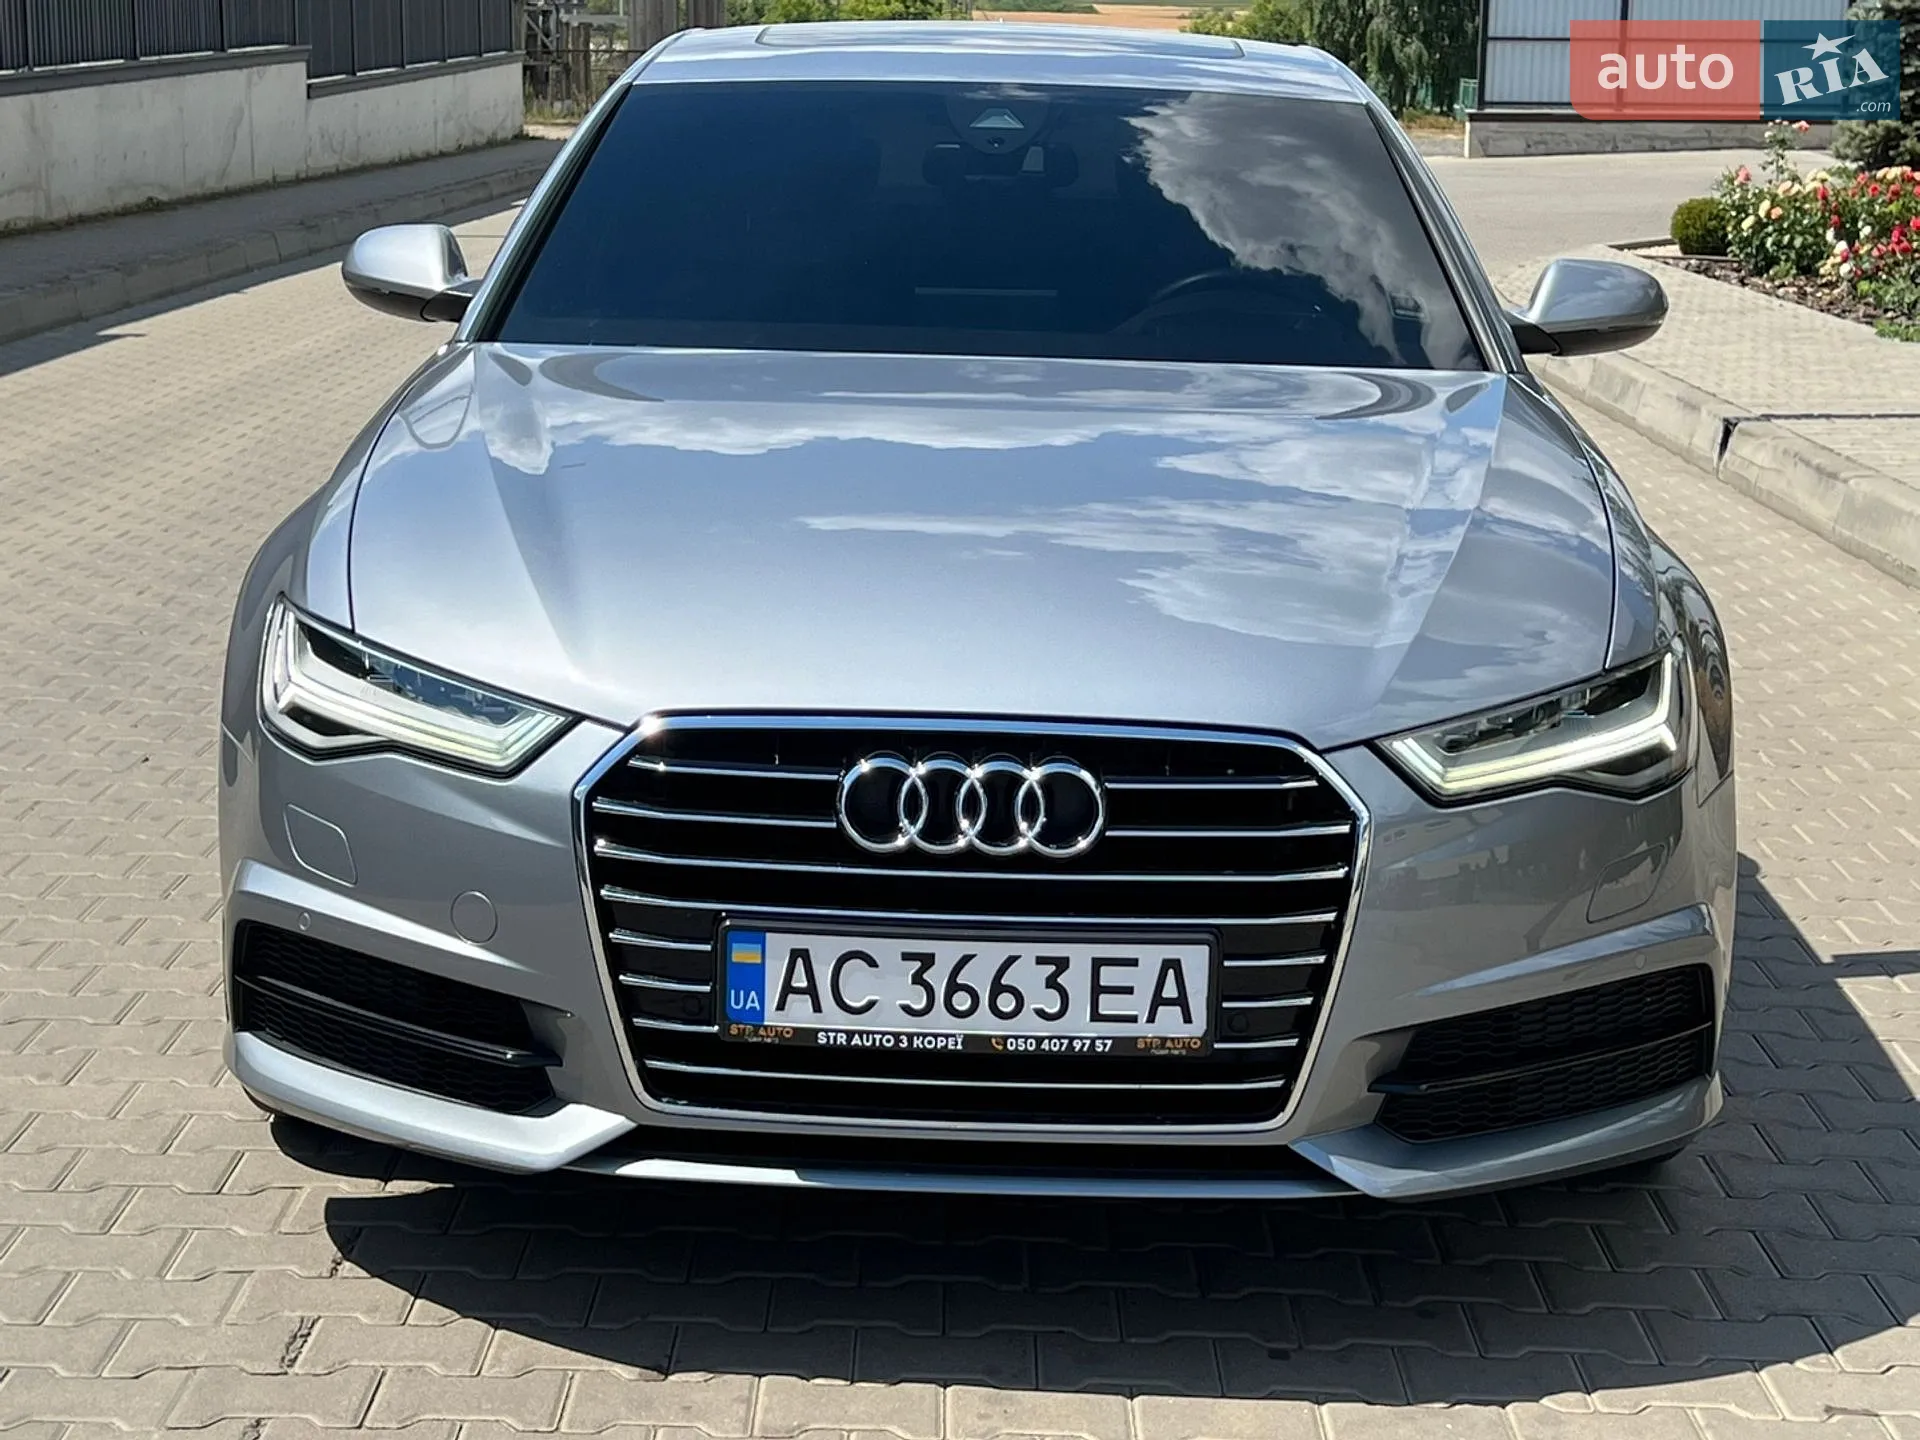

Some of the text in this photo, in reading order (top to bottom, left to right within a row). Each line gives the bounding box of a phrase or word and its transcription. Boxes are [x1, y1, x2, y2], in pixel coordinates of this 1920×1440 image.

[774, 947, 1194, 1024] AC 3663 EA
[731, 988, 760, 1011] UA
[757, 1024, 794, 1038] AUTO
[817, 1031, 846, 1045] STR
[850, 1033, 895, 1048] AUTO
[1006, 1038, 1113, 1053] 050 407 97 57
[1164, 1038, 1202, 1050] AUTO
